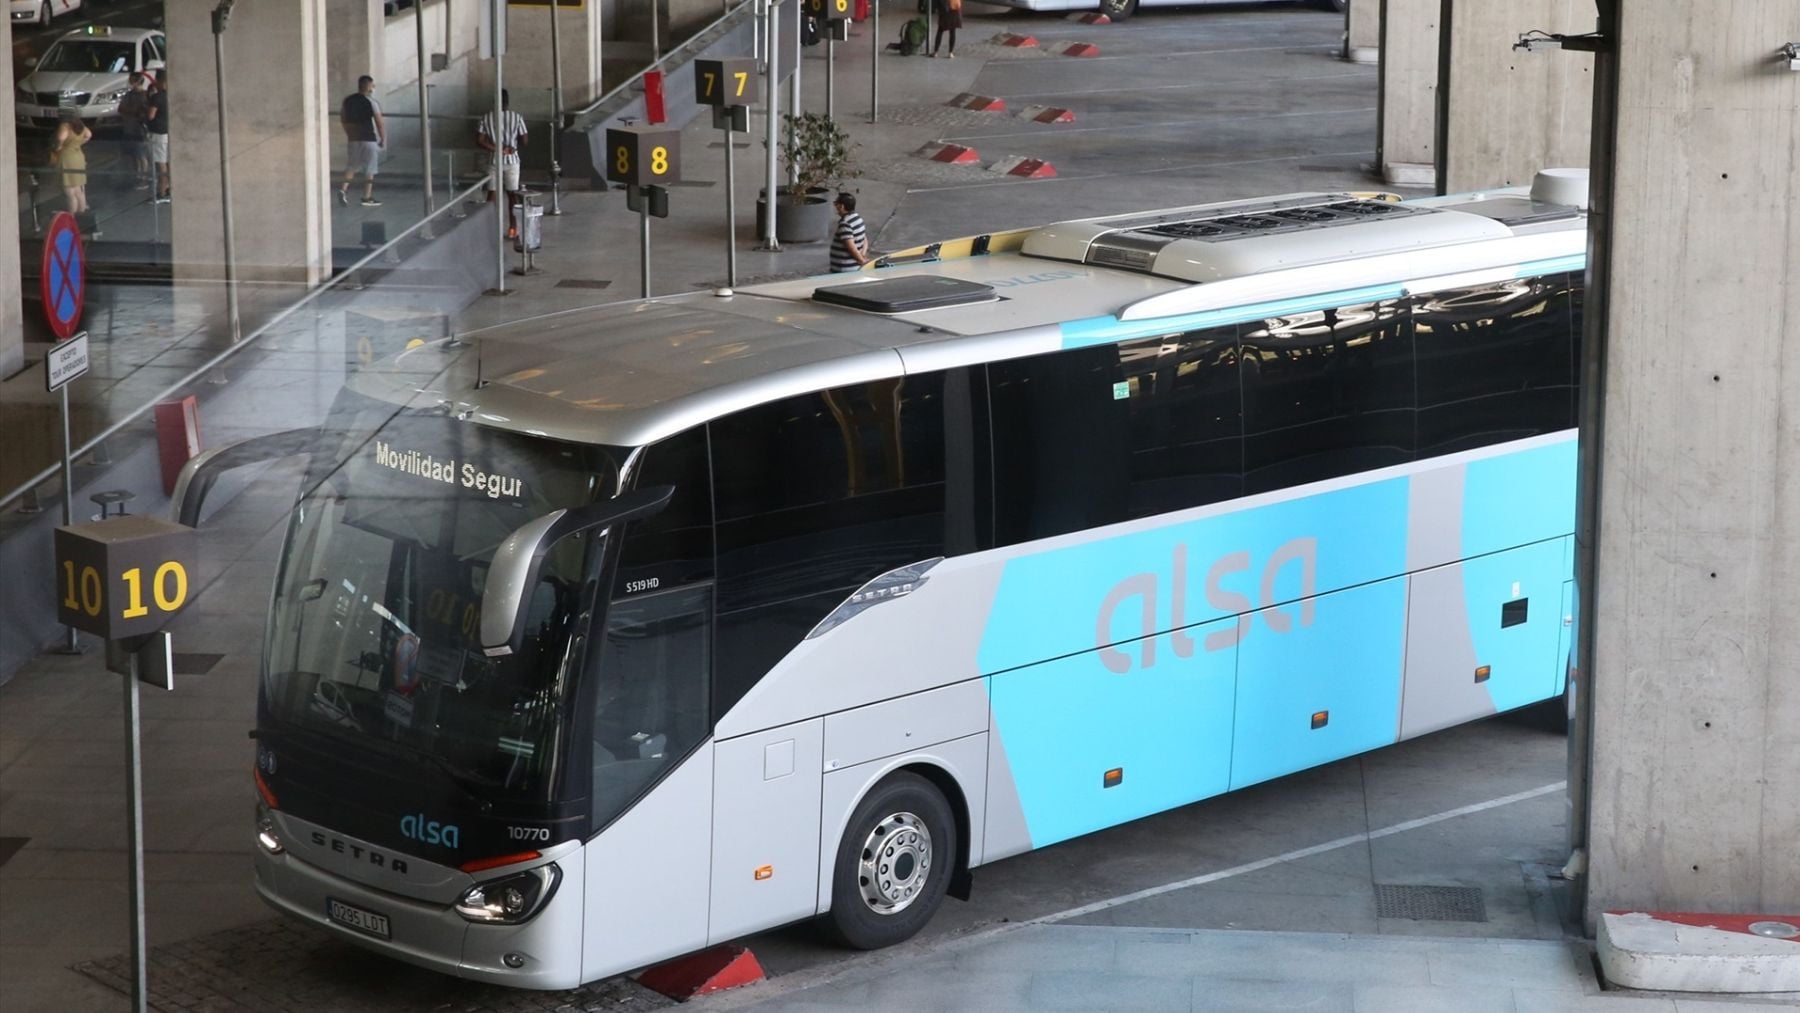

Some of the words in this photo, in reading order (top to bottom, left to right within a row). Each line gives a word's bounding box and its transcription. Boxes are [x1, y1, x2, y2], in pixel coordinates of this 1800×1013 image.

[704, 72, 714, 96] 7
[734, 72, 747, 96] 7
[617, 146, 629, 174] 8
[651, 146, 668, 175] 8
[376, 441, 455, 484] Movilidad
[461, 463, 522, 499] Segur
[63, 560, 103, 617] 10
[121, 561, 188, 619] 10
[626, 582, 632, 593] S
[632, 580, 646, 592] 519
[646, 577, 659, 589] HD
[1096, 537, 1317, 674] alsa
[400, 813, 459, 849] alsa
[507, 825, 550, 841] 10770
[311, 831, 408, 875] SETRA
[333, 903, 360, 925] 0295
